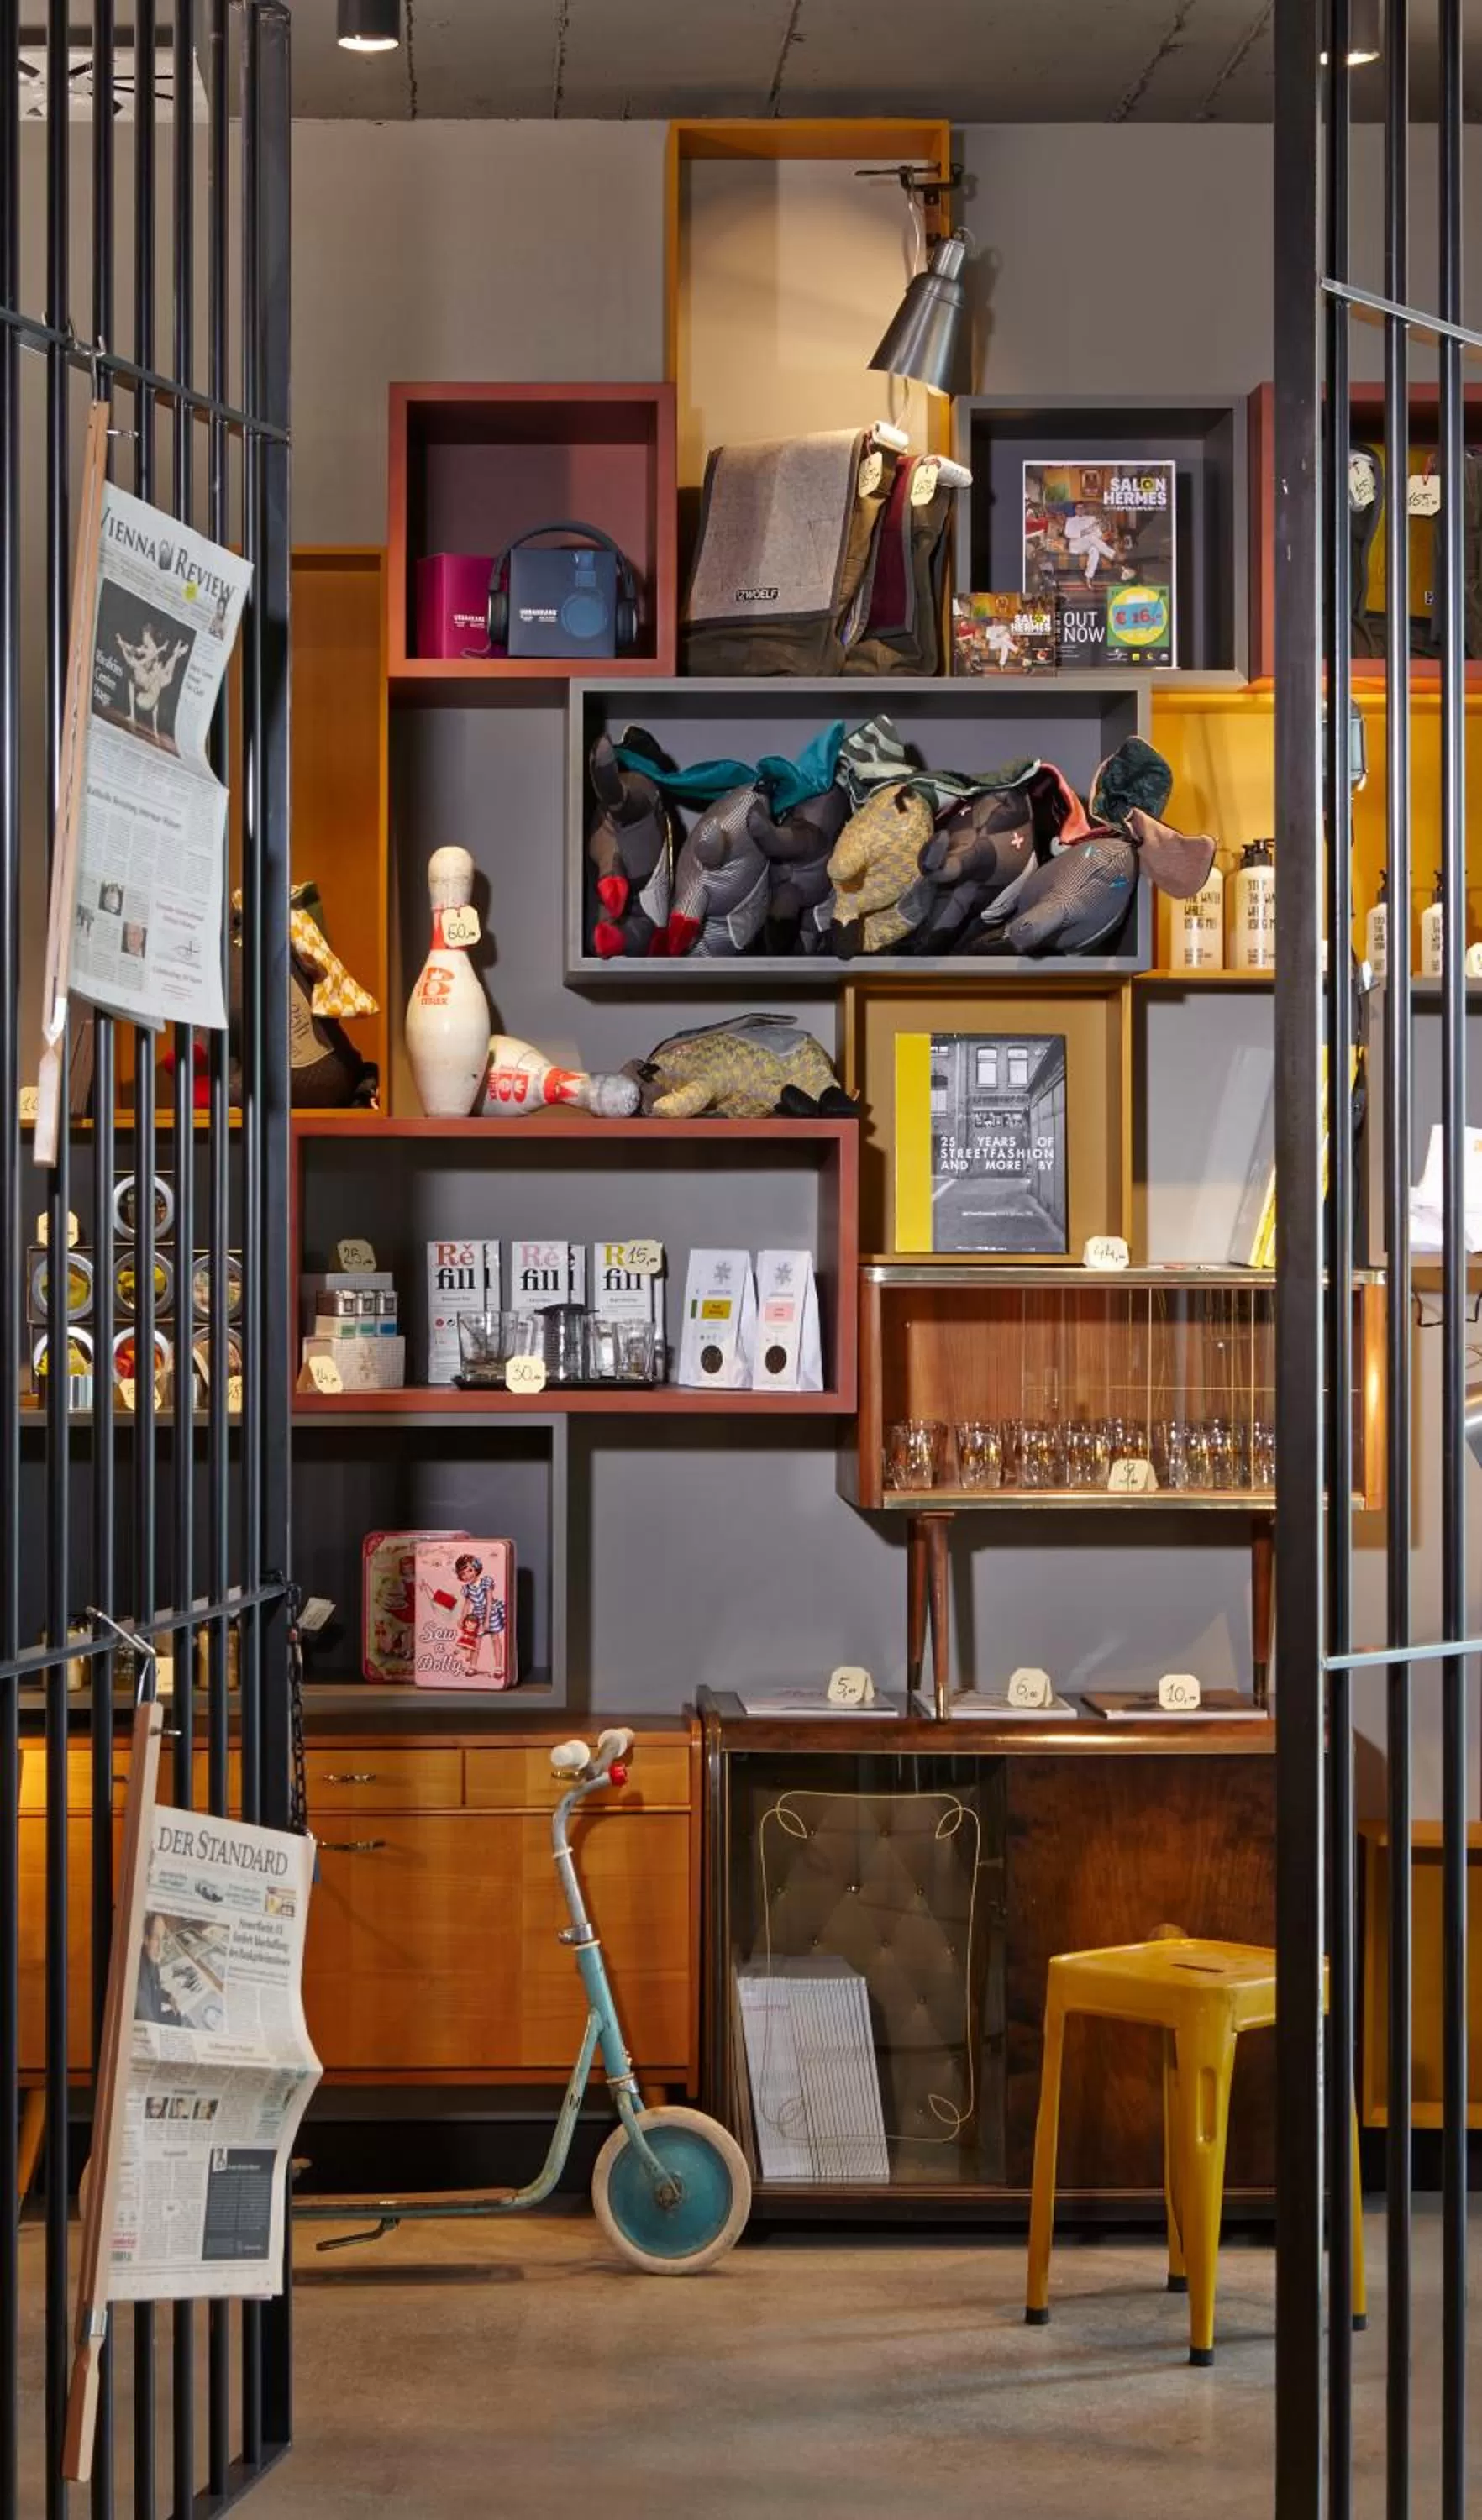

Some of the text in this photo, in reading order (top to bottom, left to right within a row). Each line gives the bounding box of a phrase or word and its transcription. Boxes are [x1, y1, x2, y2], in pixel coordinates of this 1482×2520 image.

[1110, 476, 1166, 491] SALON
[1103, 491, 1167, 505] HERMES
[175, 547, 239, 598] REVIEW
[1063, 611, 1098, 627] OUT
[1064, 627, 1105, 643] NOW
[940, 1137, 1054, 1147] 25 YEARS OF
[940, 1148, 1054, 1158] STREETFASHION
[940, 1160, 1054, 1170] AND MORE BY
[603, 1244, 626, 1267] R
[435, 1268, 476, 1290] fill
[520, 1268, 561, 1291] fill
[602, 1268, 644, 1290] fill
[157, 1826, 289, 1877] DER STANDARD
